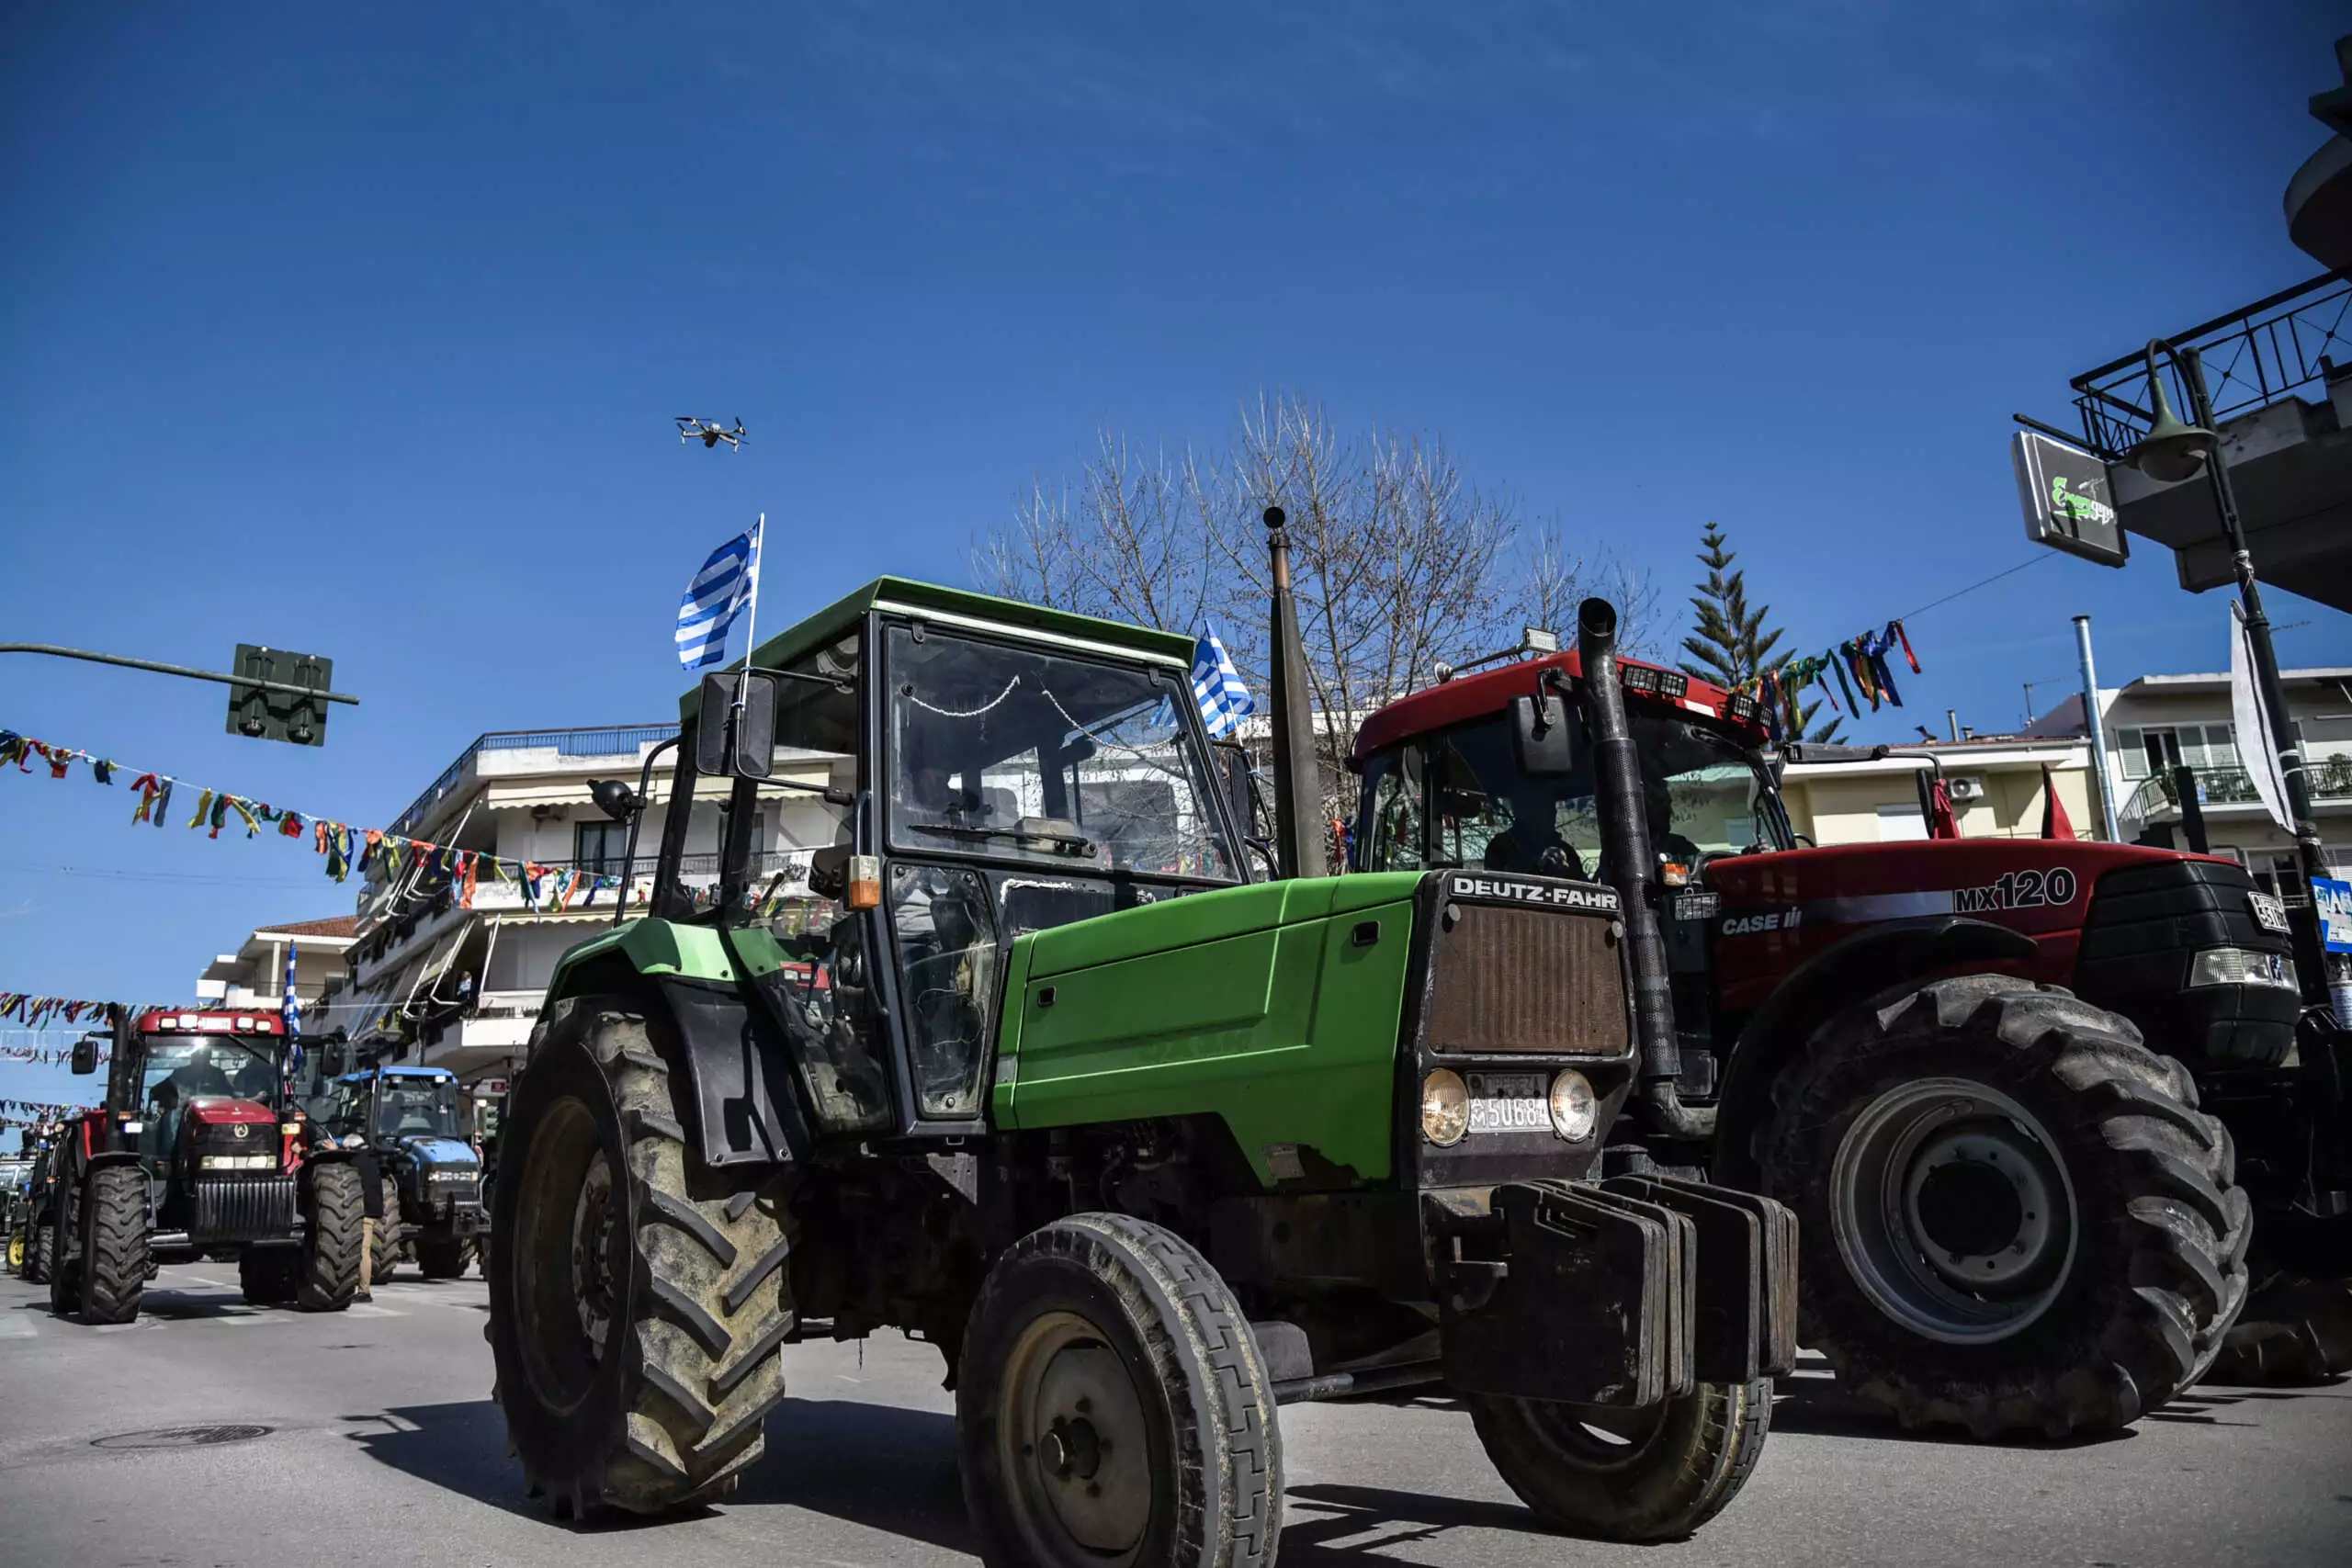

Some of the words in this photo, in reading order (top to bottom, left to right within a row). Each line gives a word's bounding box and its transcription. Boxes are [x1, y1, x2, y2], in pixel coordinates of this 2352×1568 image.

[1453, 877, 1618, 908] DEUTZ-FAHR
[1954, 866, 2076, 913] MX120
[1722, 913, 1780, 935] CASE
